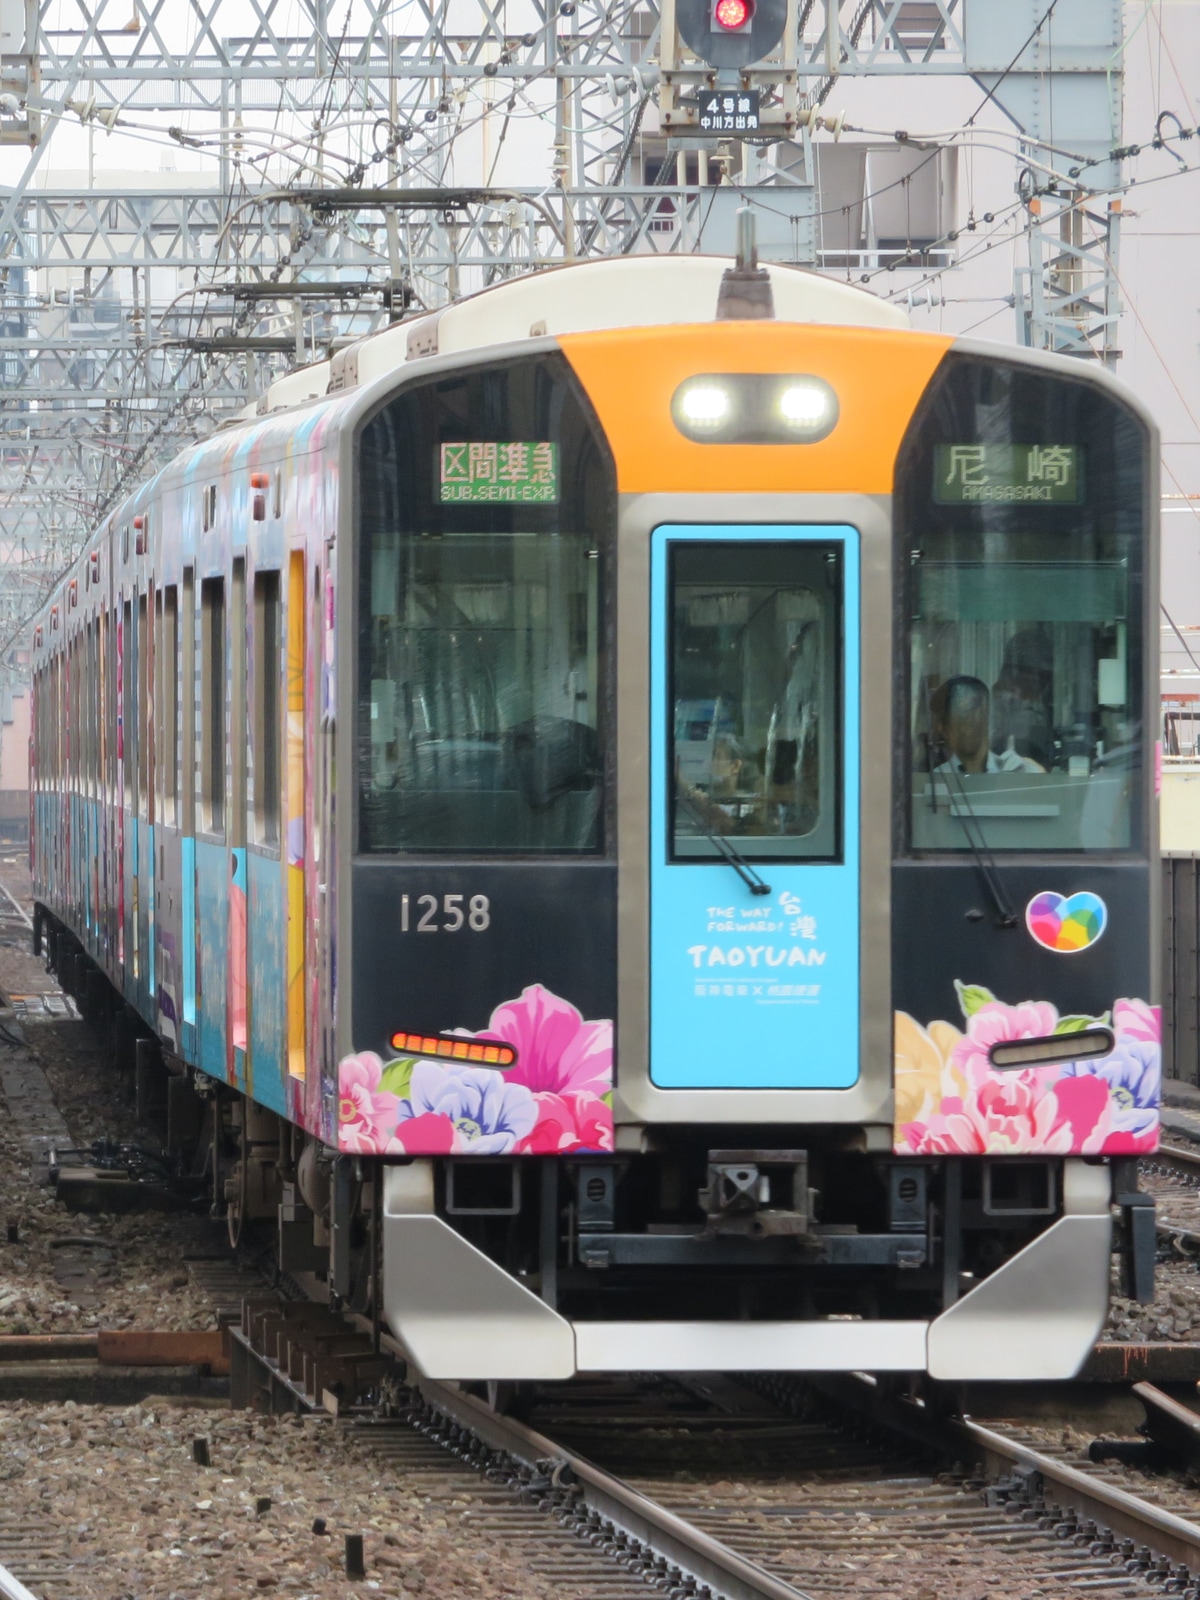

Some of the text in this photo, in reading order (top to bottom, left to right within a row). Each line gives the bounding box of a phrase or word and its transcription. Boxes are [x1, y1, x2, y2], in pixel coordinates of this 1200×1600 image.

[706, 97, 750, 114] 4号線
[700, 115, 758, 129] 中川方出発
[440, 442, 556, 483] 区間準急
[945, 444, 1072, 486] 尼崎
[401, 894, 491, 932] 1258
[706, 906, 772, 918] THE WAY
[706, 921, 784, 932] FORWARD!
[687, 944, 827, 968] TAOYUAN
